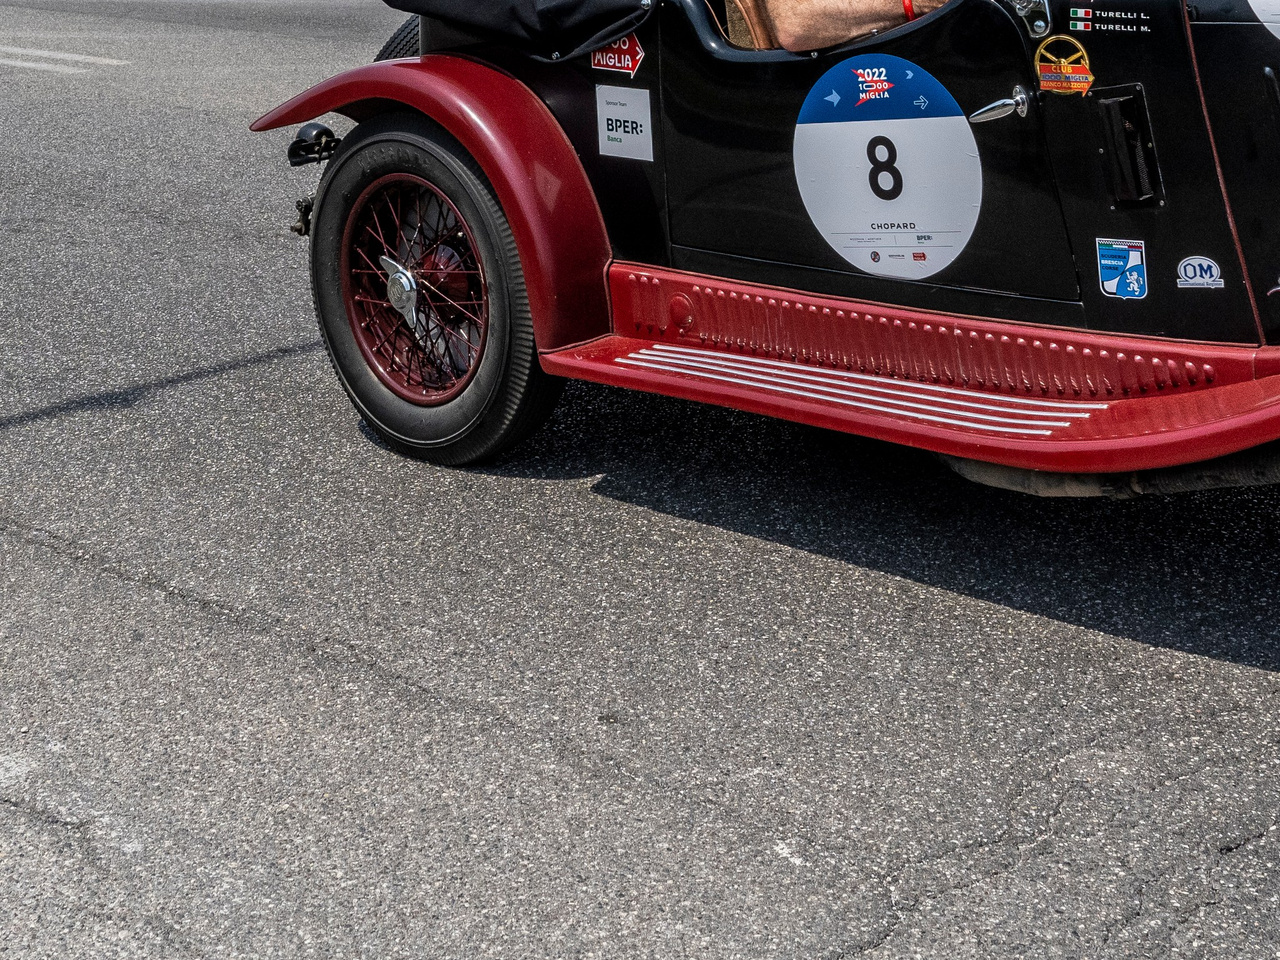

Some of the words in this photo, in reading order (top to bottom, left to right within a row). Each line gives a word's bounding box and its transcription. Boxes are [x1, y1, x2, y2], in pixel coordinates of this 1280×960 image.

[1095, 10, 1137, 19] TURELLI
[1095, 23, 1137, 32] TURELLI
[606, 37, 629, 50] 00
[595, 51, 632, 68] MIGLIA
[1051, 65, 1073, 73] CLUB
[857, 68, 887, 81] 2022
[859, 82, 889, 90] 1000
[859, 91, 890, 99] MIGLIA
[606, 118, 643, 135] BPER:
[607, 135, 622, 143] Banca
[866, 135, 904, 201] 8
[870, 222, 916, 230] CHOPARD
[1183, 262, 1215, 280] OM
